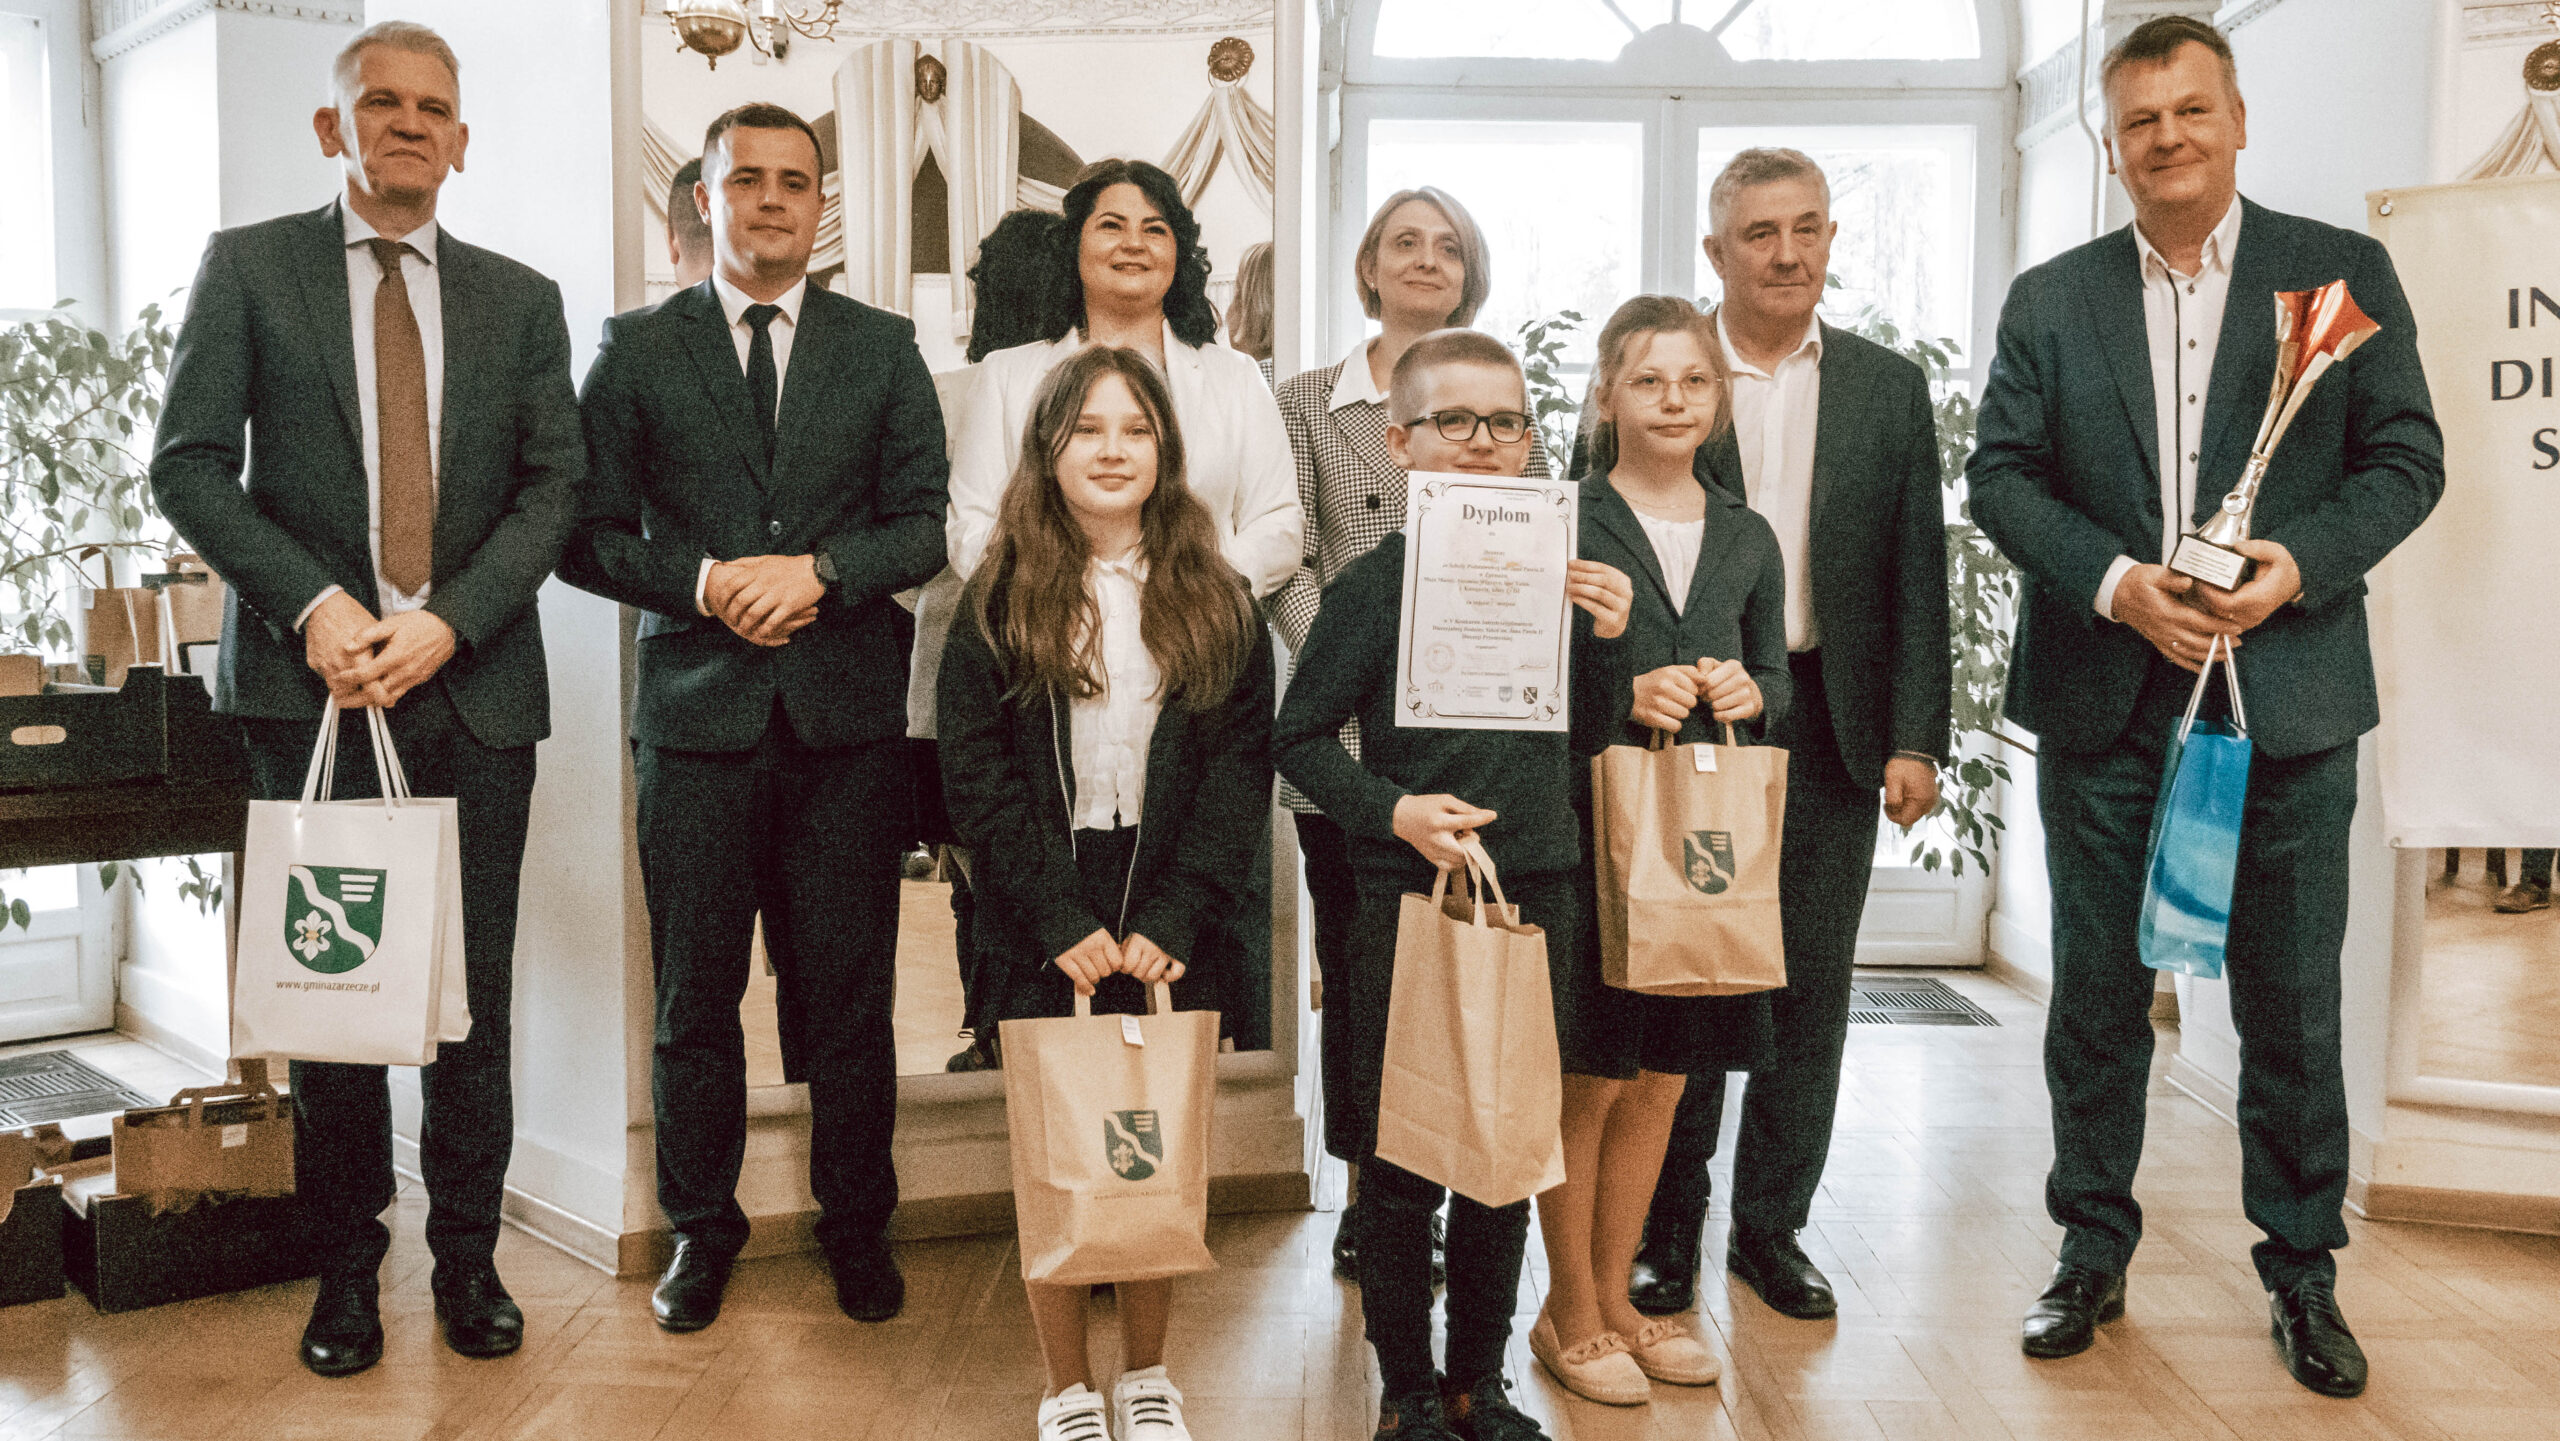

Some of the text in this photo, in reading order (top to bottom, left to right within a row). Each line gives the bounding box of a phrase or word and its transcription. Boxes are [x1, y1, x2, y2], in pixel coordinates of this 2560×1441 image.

[2491, 357, 2553, 401] DI
[2532, 427, 2560, 470] S
[1463, 504, 1530, 525] Dyplom
[276, 980, 380, 994] www.gminazarzecze.pl
